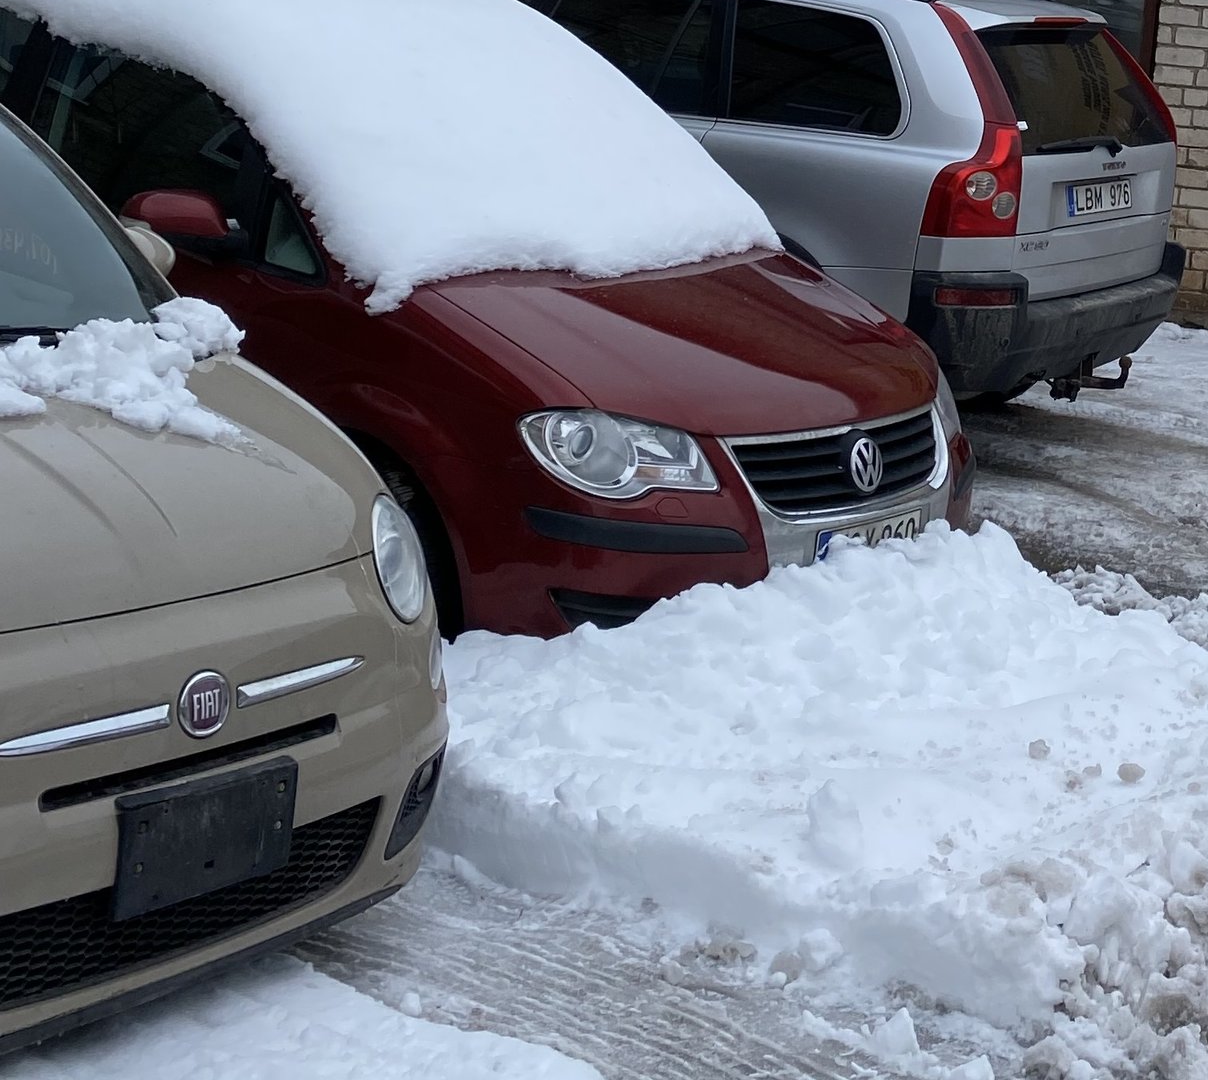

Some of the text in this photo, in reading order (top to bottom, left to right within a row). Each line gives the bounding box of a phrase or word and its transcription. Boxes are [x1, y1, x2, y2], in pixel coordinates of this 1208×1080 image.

[1075, 186, 1103, 212] LBM
[1109, 183, 1130, 207] 976
[192, 688, 221, 722] FIAT
